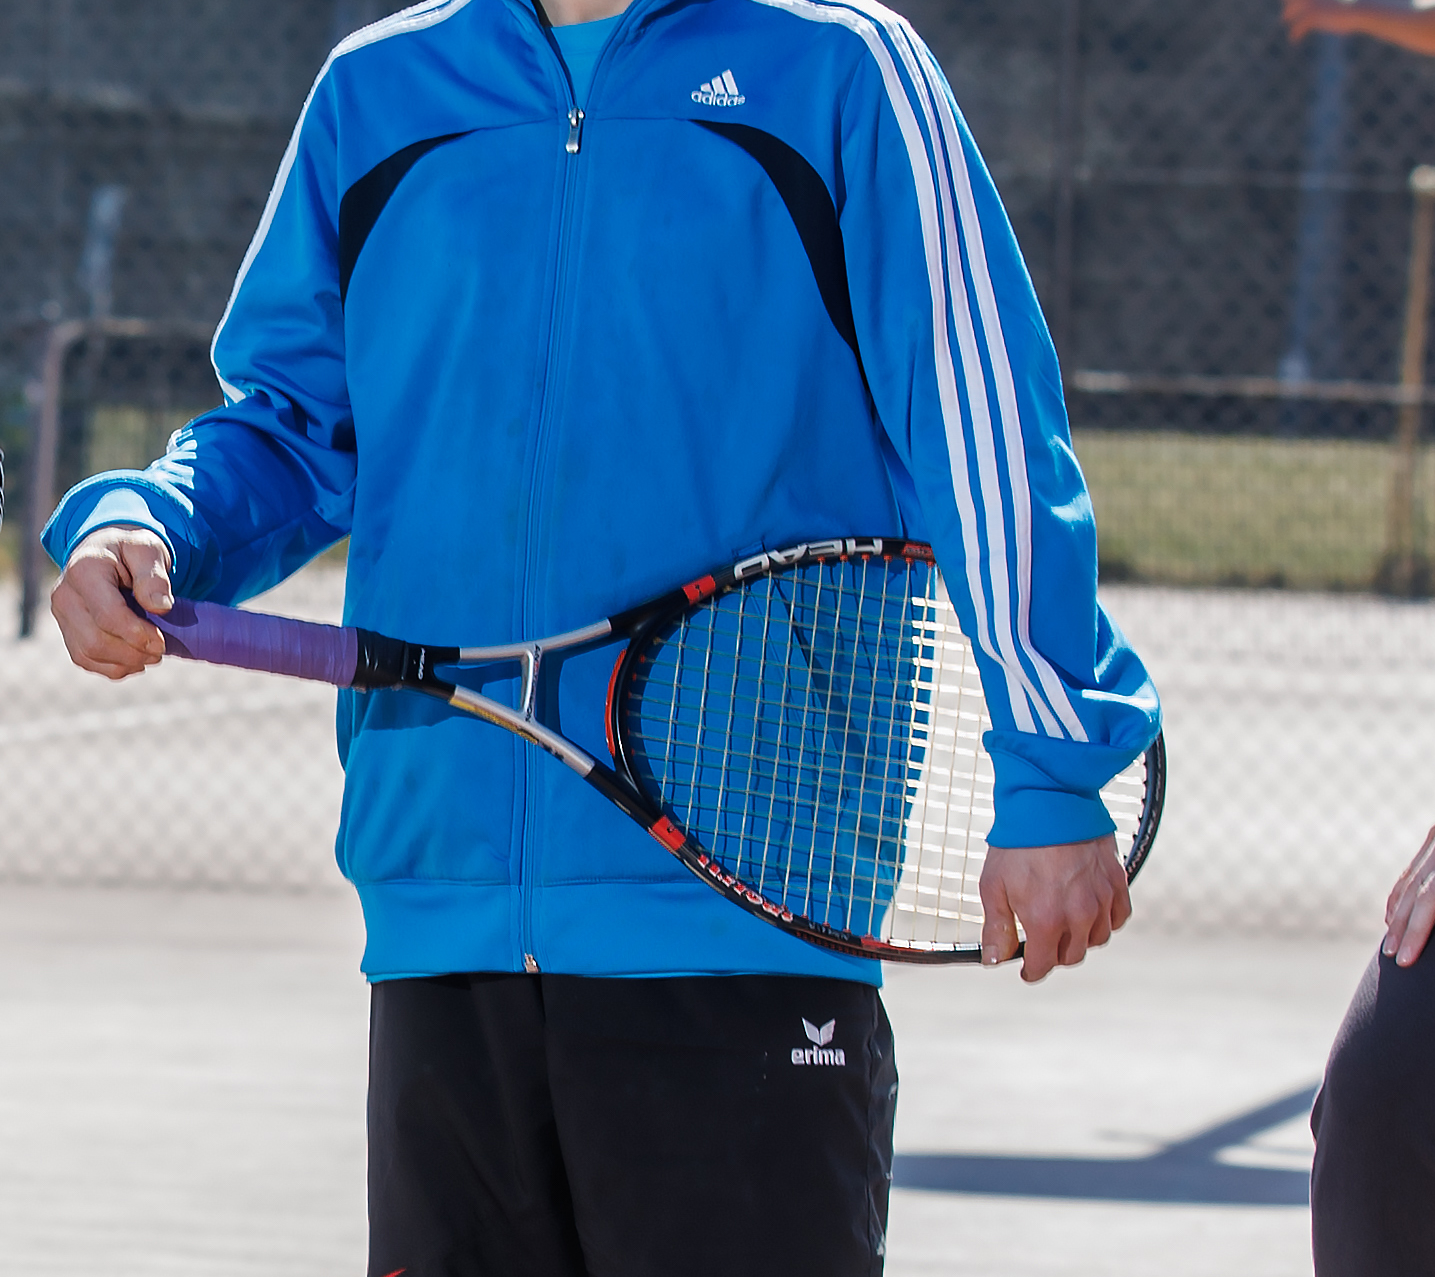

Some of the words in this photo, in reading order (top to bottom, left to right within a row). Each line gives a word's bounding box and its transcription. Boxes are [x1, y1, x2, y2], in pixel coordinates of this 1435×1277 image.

[690, 90, 745, 107] adidas
[733, 537, 883, 581] HEAD
[791, 1045, 846, 1066] erima
